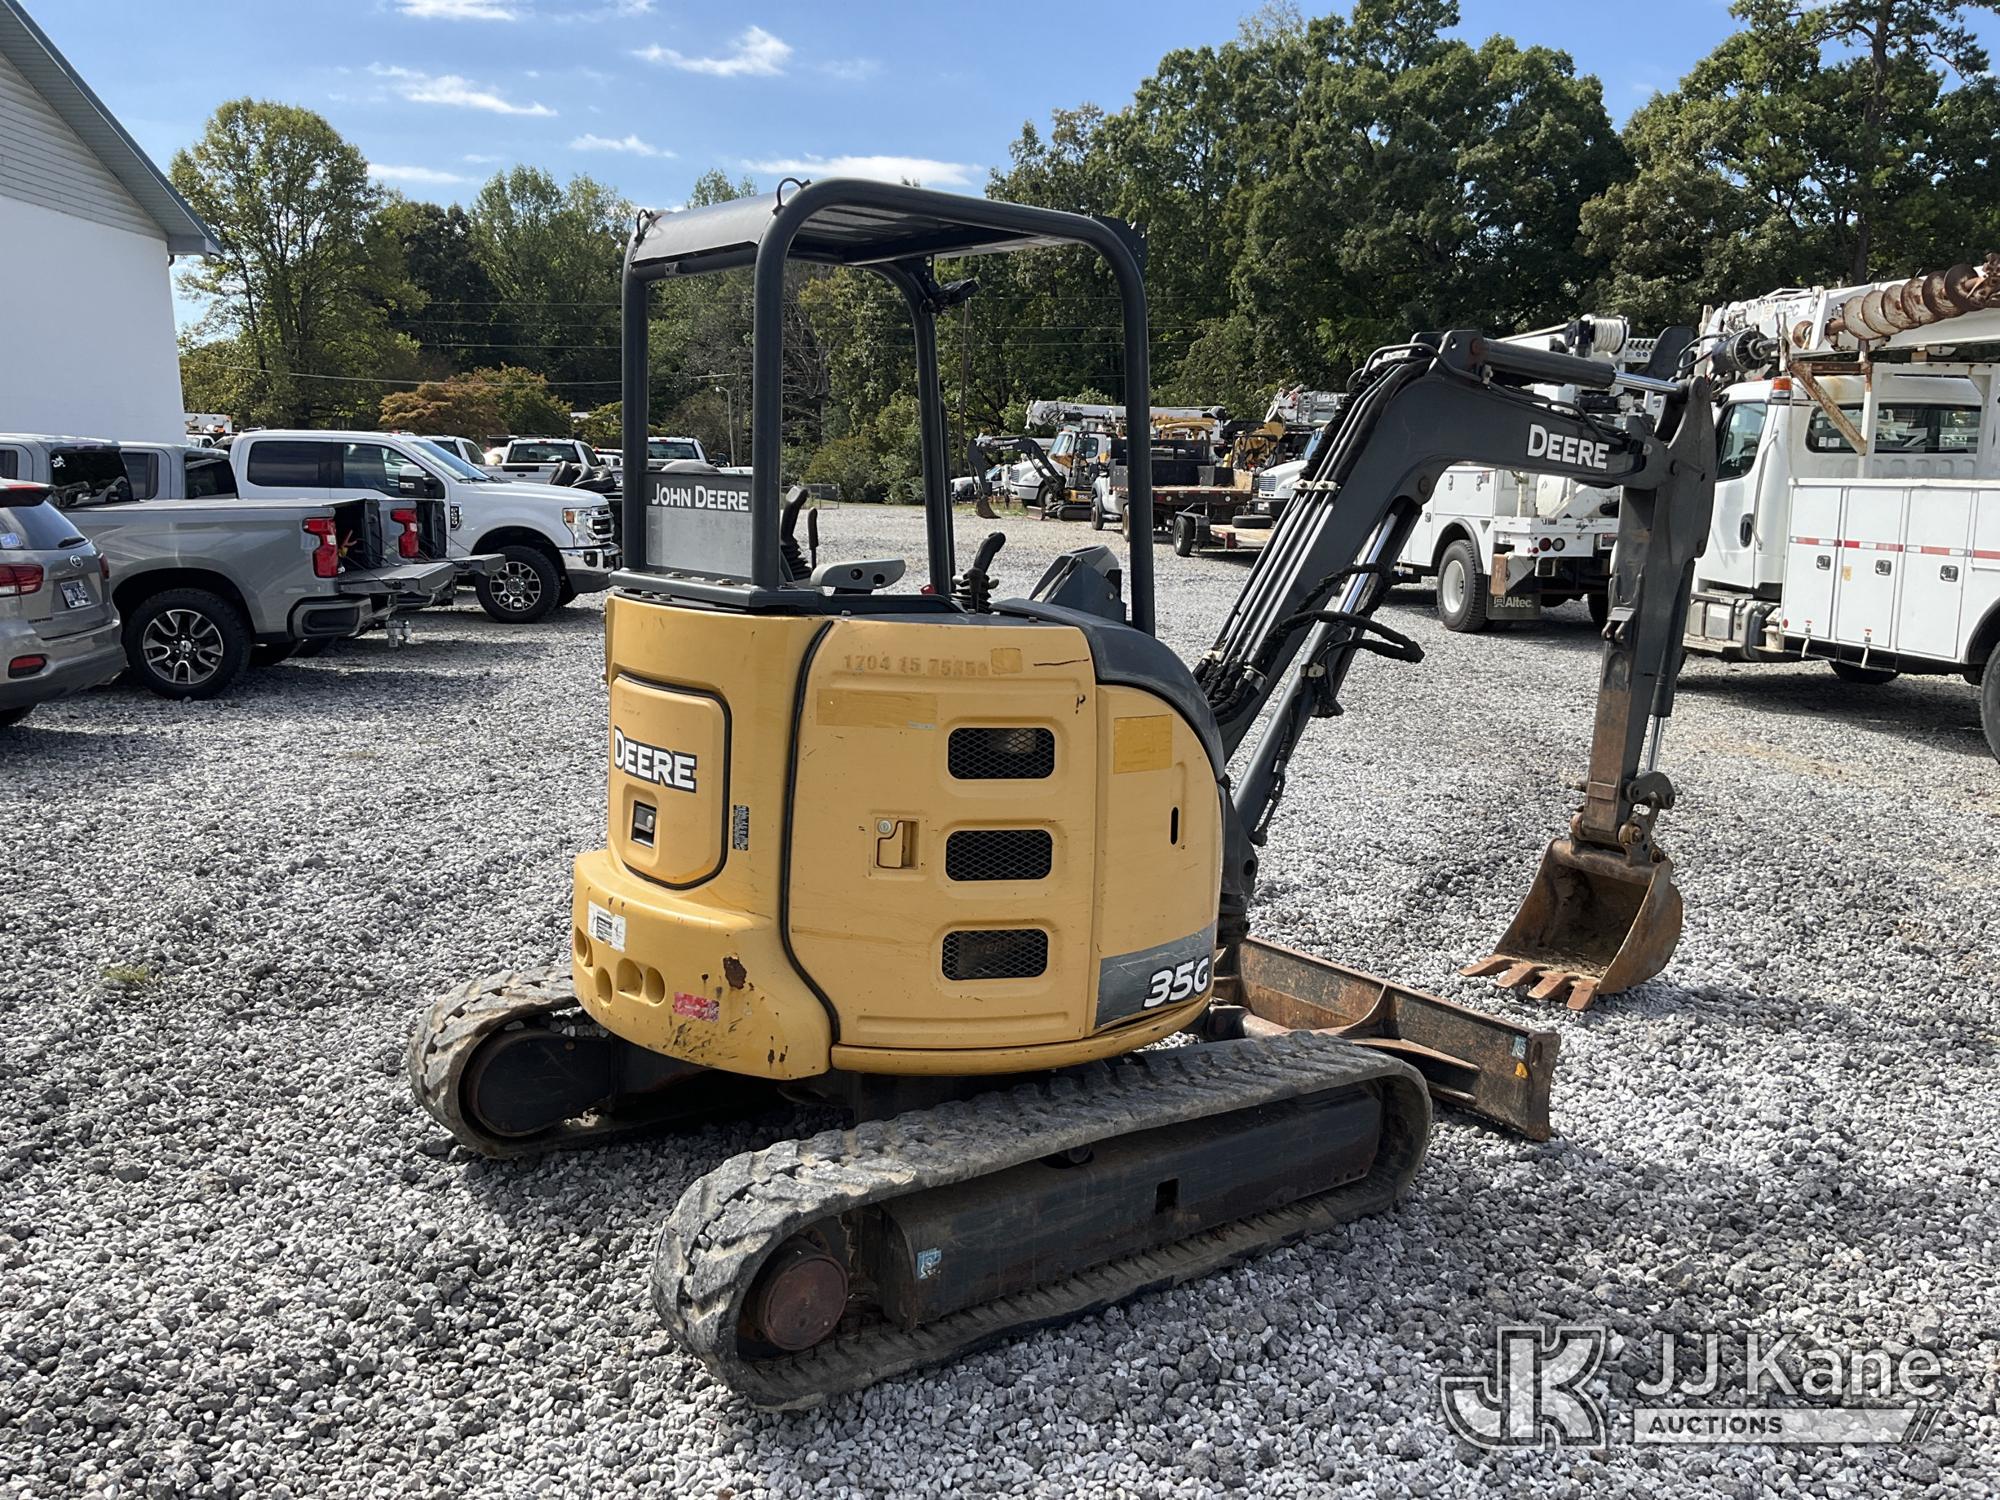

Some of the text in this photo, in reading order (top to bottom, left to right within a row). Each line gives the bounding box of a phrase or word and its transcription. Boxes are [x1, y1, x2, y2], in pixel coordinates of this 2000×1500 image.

[1527, 423, 1610, 469] DEERE
[651, 483, 749, 511] JOHN DEERE
[1505, 597, 1533, 608] Altec
[614, 728, 695, 790] DEERE
[1143, 956, 1209, 1009] 35G
